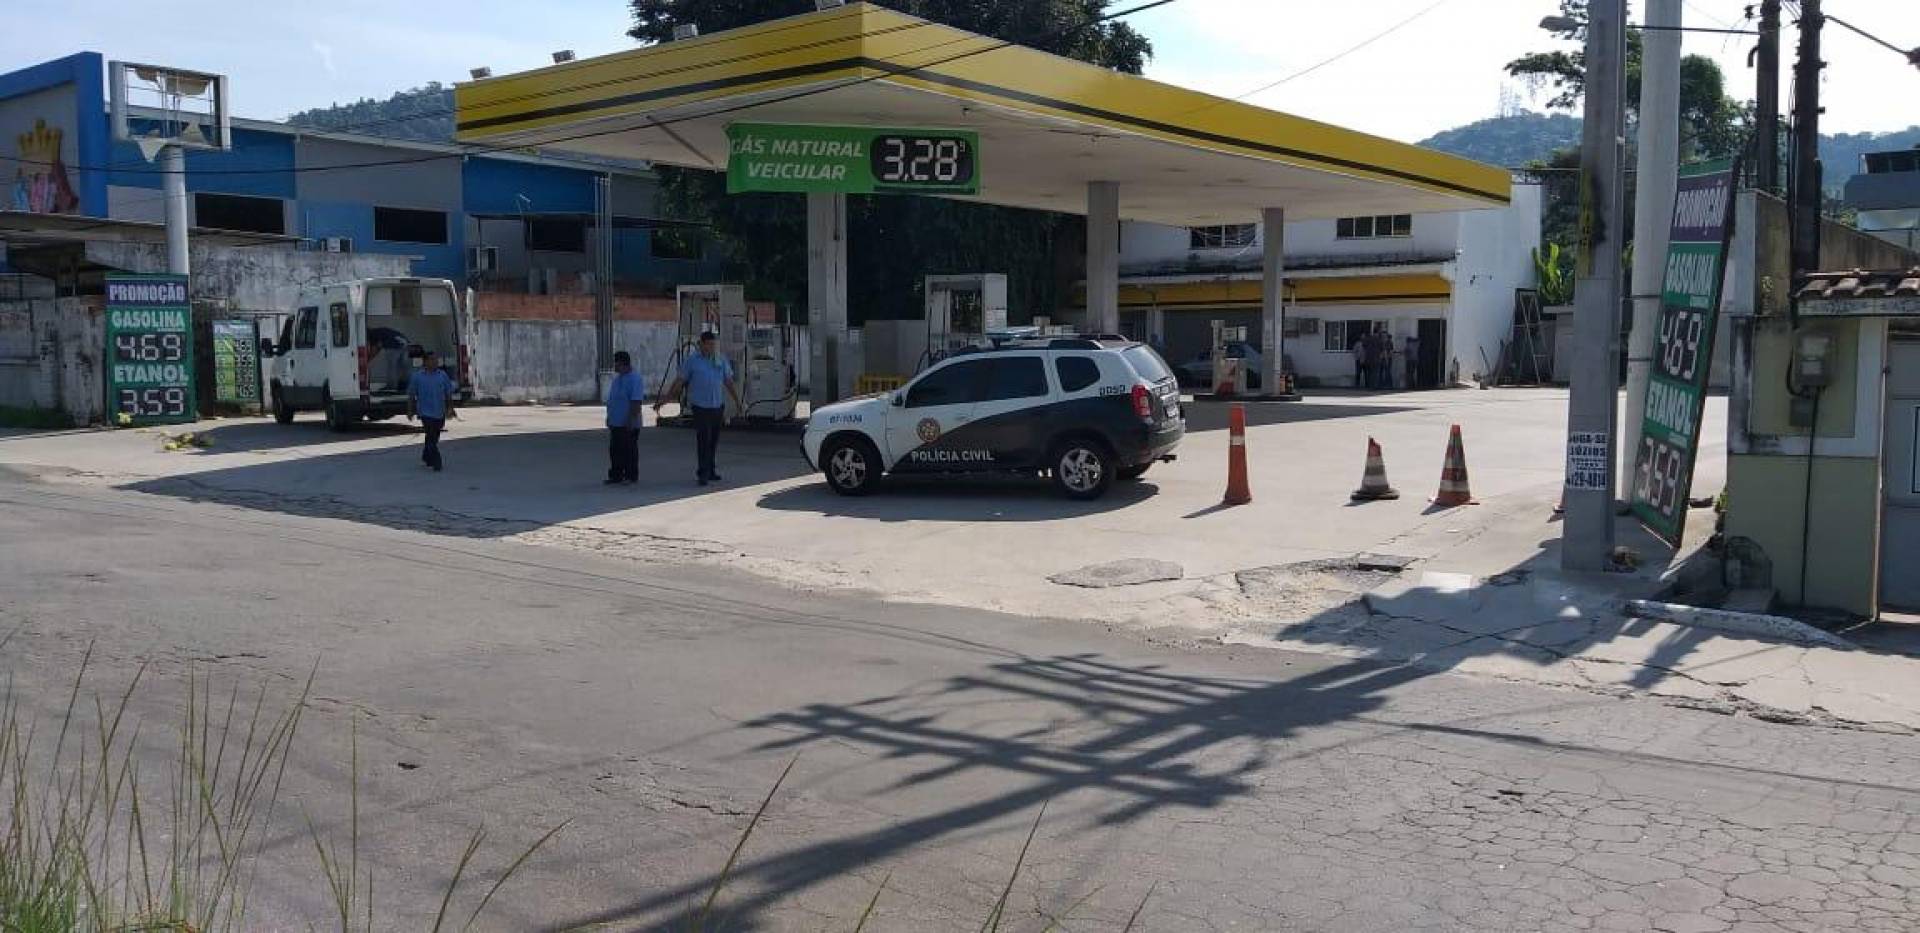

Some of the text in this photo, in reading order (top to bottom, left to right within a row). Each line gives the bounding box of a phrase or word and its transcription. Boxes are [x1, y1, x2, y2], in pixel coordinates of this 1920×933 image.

[771, 139, 865, 158] NATURAL
[747, 161, 846, 181] VEICULAR
[1672, 179, 1729, 237] PROMOÇÃO
[1665, 252, 1717, 297] GASOLINA
[109, 283, 186, 304] PROMOÇÃO
[111, 311, 186, 329] GASOLINA
[116, 334, 182, 361] 4.69
[114, 364, 189, 383] ETANOL
[120, 389, 184, 415] 3.59
[1646, 380, 1694, 436] ETANOL
[911, 447, 995, 463] POLÍCIA CIVIL
